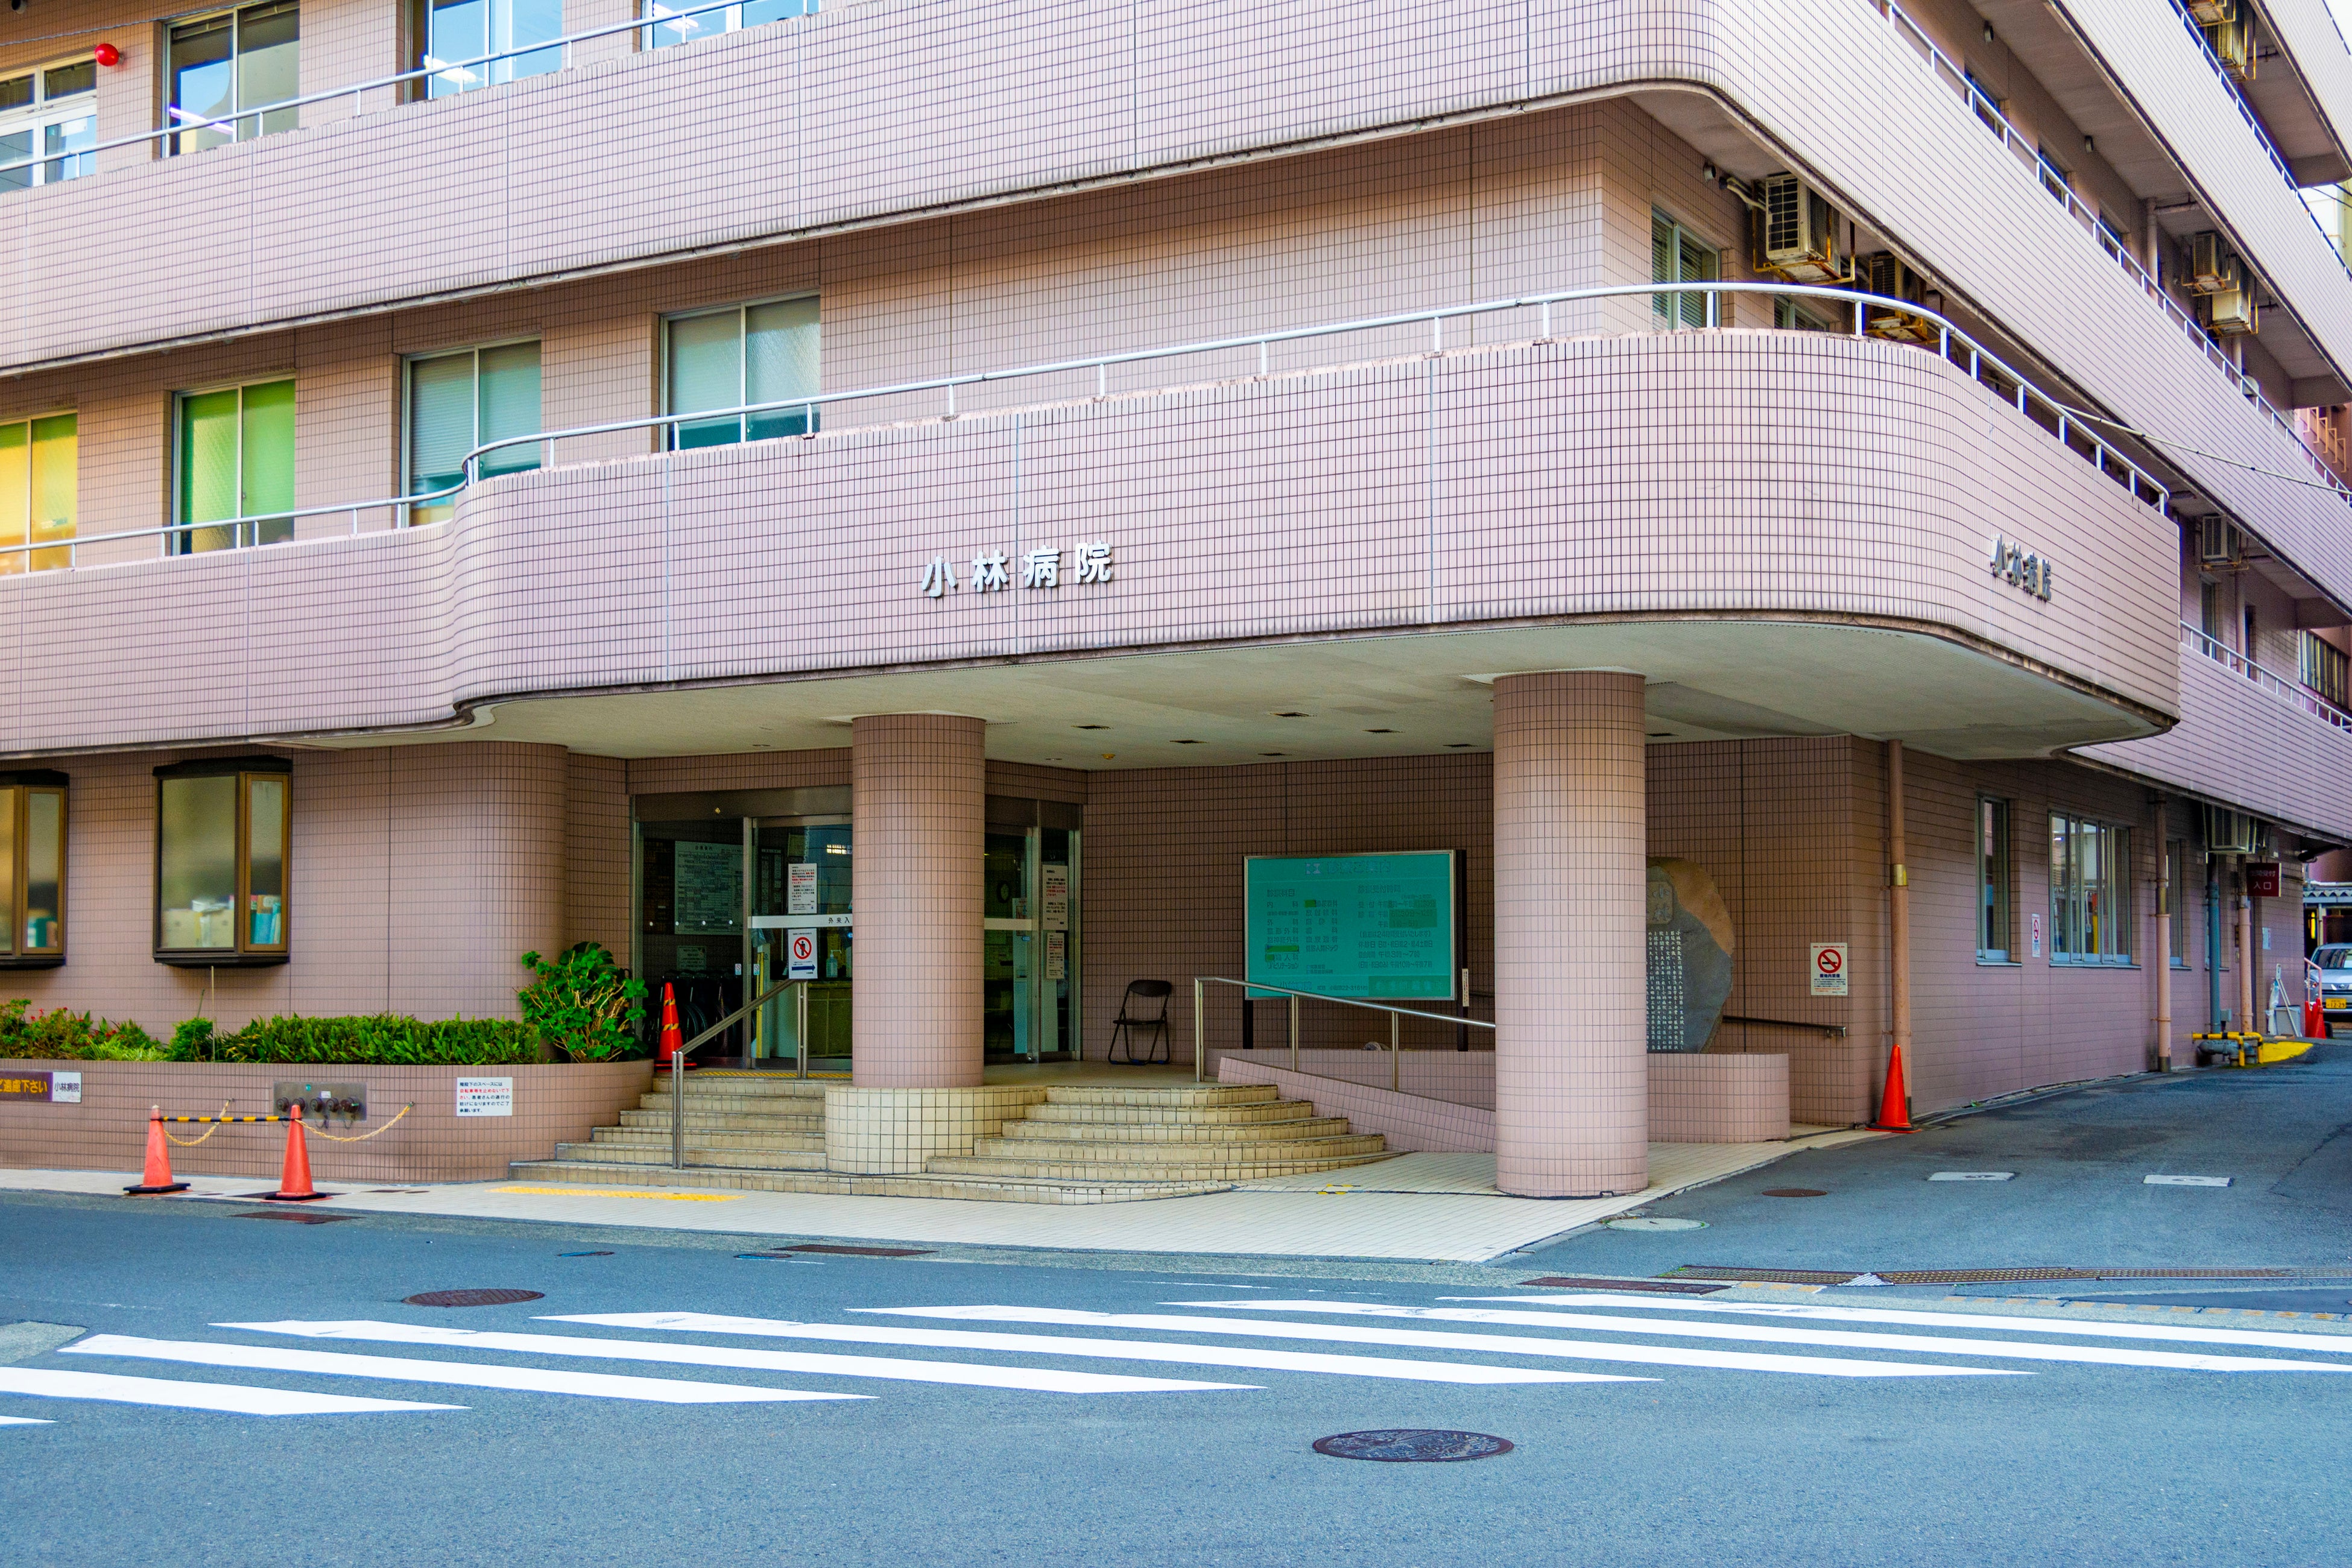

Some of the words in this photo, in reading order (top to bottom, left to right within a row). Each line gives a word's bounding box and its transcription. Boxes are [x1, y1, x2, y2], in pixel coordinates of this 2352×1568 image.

[922, 540, 1111, 597] 小林病院
[54, 1082, 80, 1092] 小林病院
